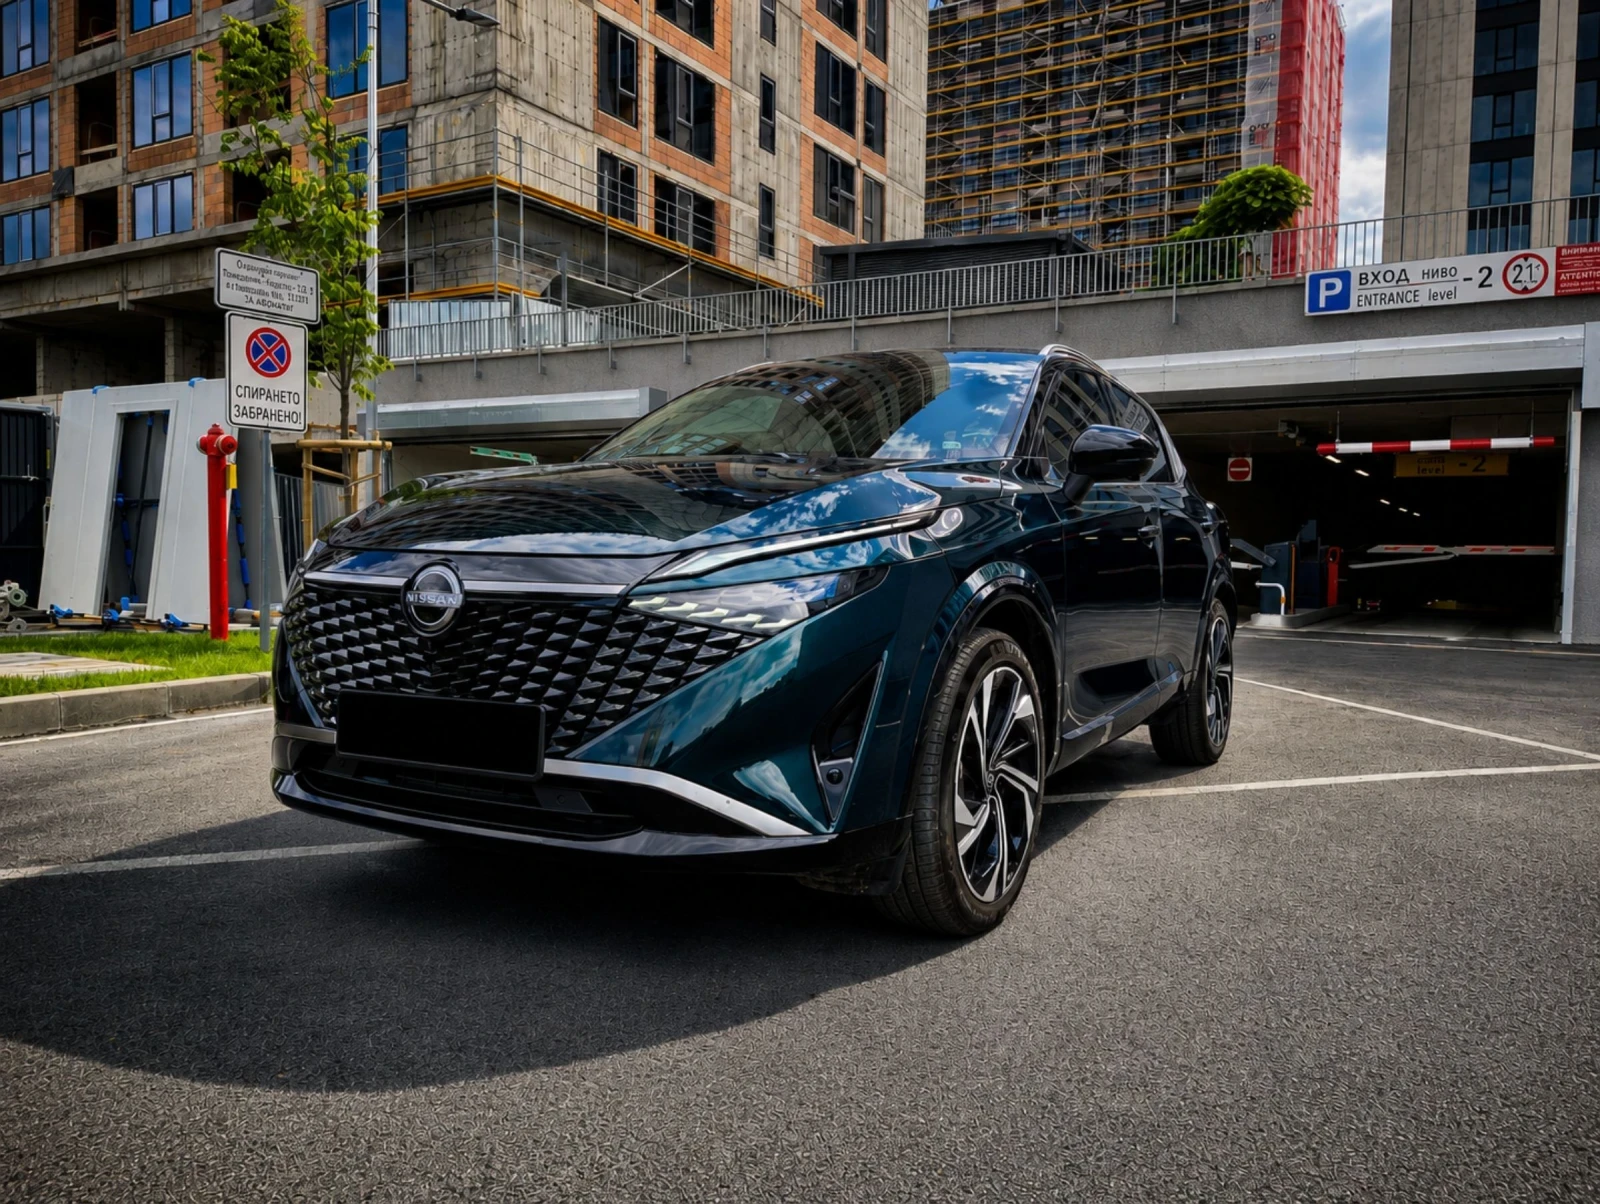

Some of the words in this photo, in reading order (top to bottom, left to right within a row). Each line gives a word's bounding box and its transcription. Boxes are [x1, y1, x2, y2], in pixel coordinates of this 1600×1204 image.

[1358, 268, 1410, 286] ВХОД
[1319, 277, 1343, 308] P
[1357, 289, 1420, 308] ENTRANCE
[1428, 286, 1457, 301] level
[235, 384, 300, 405] СПИРАНЕТО
[234, 404, 302, 425] ЗАБРАНЕНО!
[406, 592, 457, 605] NISSAN
